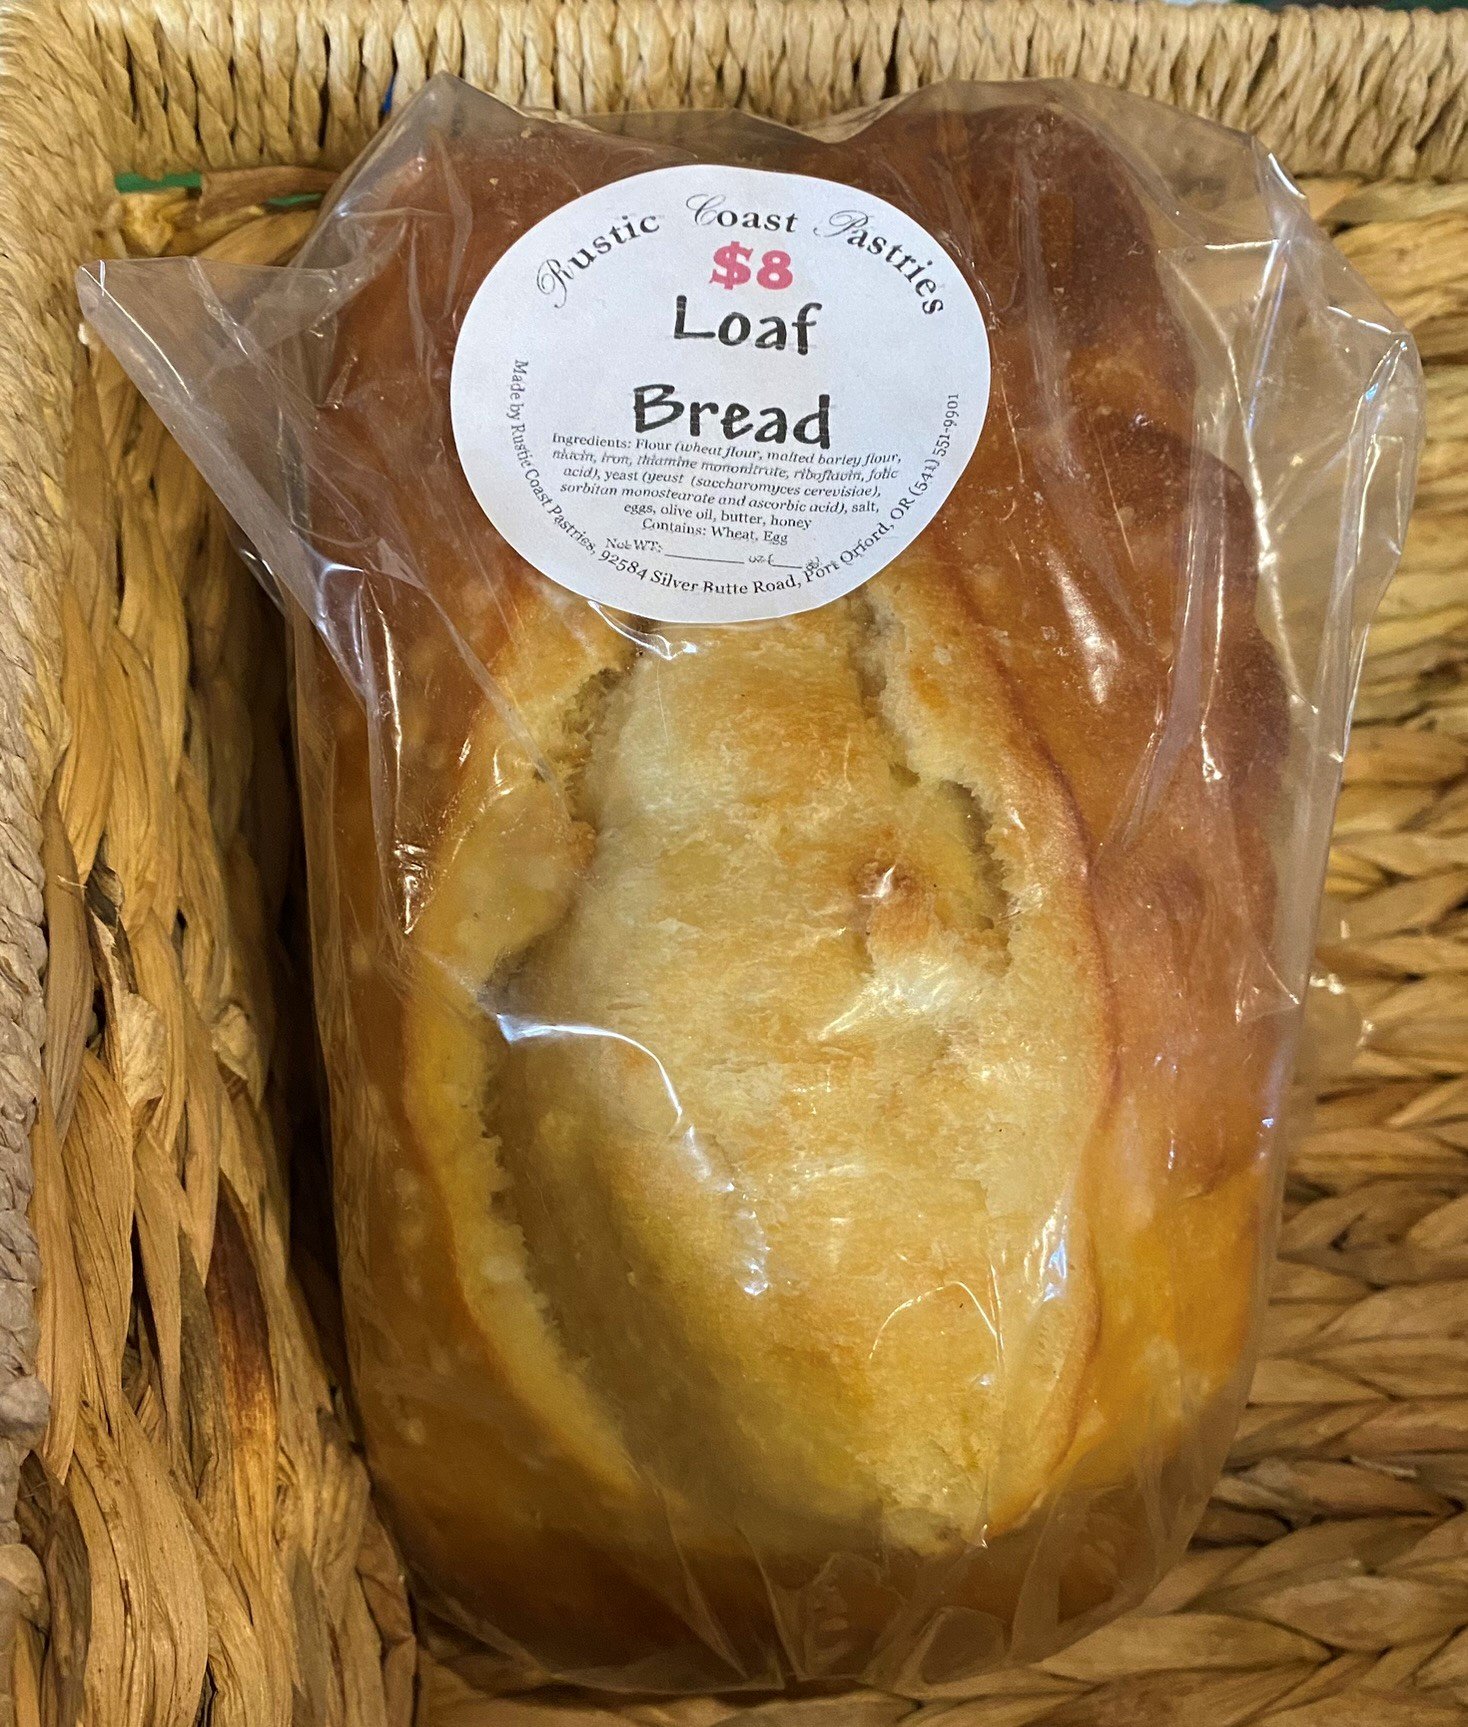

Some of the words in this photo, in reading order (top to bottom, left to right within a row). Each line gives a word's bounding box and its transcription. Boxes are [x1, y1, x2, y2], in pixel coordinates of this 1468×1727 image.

[536, 215, 661, 309] Rustic
[685, 193, 799, 233] Coast
[813, 210, 944, 316] Pastries
[708, 241, 793, 291] $8
[673, 295, 822, 356] Loaf
[511, 359, 529, 400] Made
[506, 403, 525, 420] by
[633, 383, 831, 450] Bread
[932, 393, 959, 458] 551-9901
[511, 423, 532, 468] Rustic
[552, 433, 631, 449] Ingredients:
[635, 438, 671, 451] Flour
[674, 442, 722, 456] (wheat
[722, 446, 763, 460] flour,
[767, 450, 814, 464] malted
[818, 454, 862, 467] barley
[862, 453, 901, 467] flour,
[552, 450, 597, 464] niacin,
[601, 452, 633, 467] iron,
[637, 454, 697, 469] thiamine
[794, 468, 864, 483] riboflavin,
[867, 467, 899, 482] folic
[563, 467, 600, 480] acid),
[604, 471, 638, 482] yeast
[642, 472, 684, 484] (yeast
[691, 475, 800, 495] (saccharomyces
[804, 486, 881, 498] cerevisiae),
[908, 459, 940, 497] (541)
[525, 468, 553, 507] Coast
[560, 483, 617, 496] sorbitan
[621, 487, 715, 504] monostearate
[718, 496, 746, 506] and
[749, 499, 806, 512] ascorbic
[809, 502, 848, 514] acid),
[851, 502, 880, 513] salt,
[624, 503, 656, 515] eggs,
[660, 505, 693, 518] olive
[696, 508, 717, 522] oil,
[721, 511, 766, 526] butter,
[771, 514, 812, 530] honey
[890, 498, 915, 520] OR
[548, 504, 598, 556] Pastries,
[642, 518, 706, 536] Contains:
[764, 531, 788, 545] Egg
[840, 522, 895, 565] Orford,
[598, 550, 649, 581] 92584
[650, 570, 699, 592] Silver
[804, 561, 839, 583] Port
[703, 581, 748, 594] Butte
[754, 574, 802, 594] Road,
